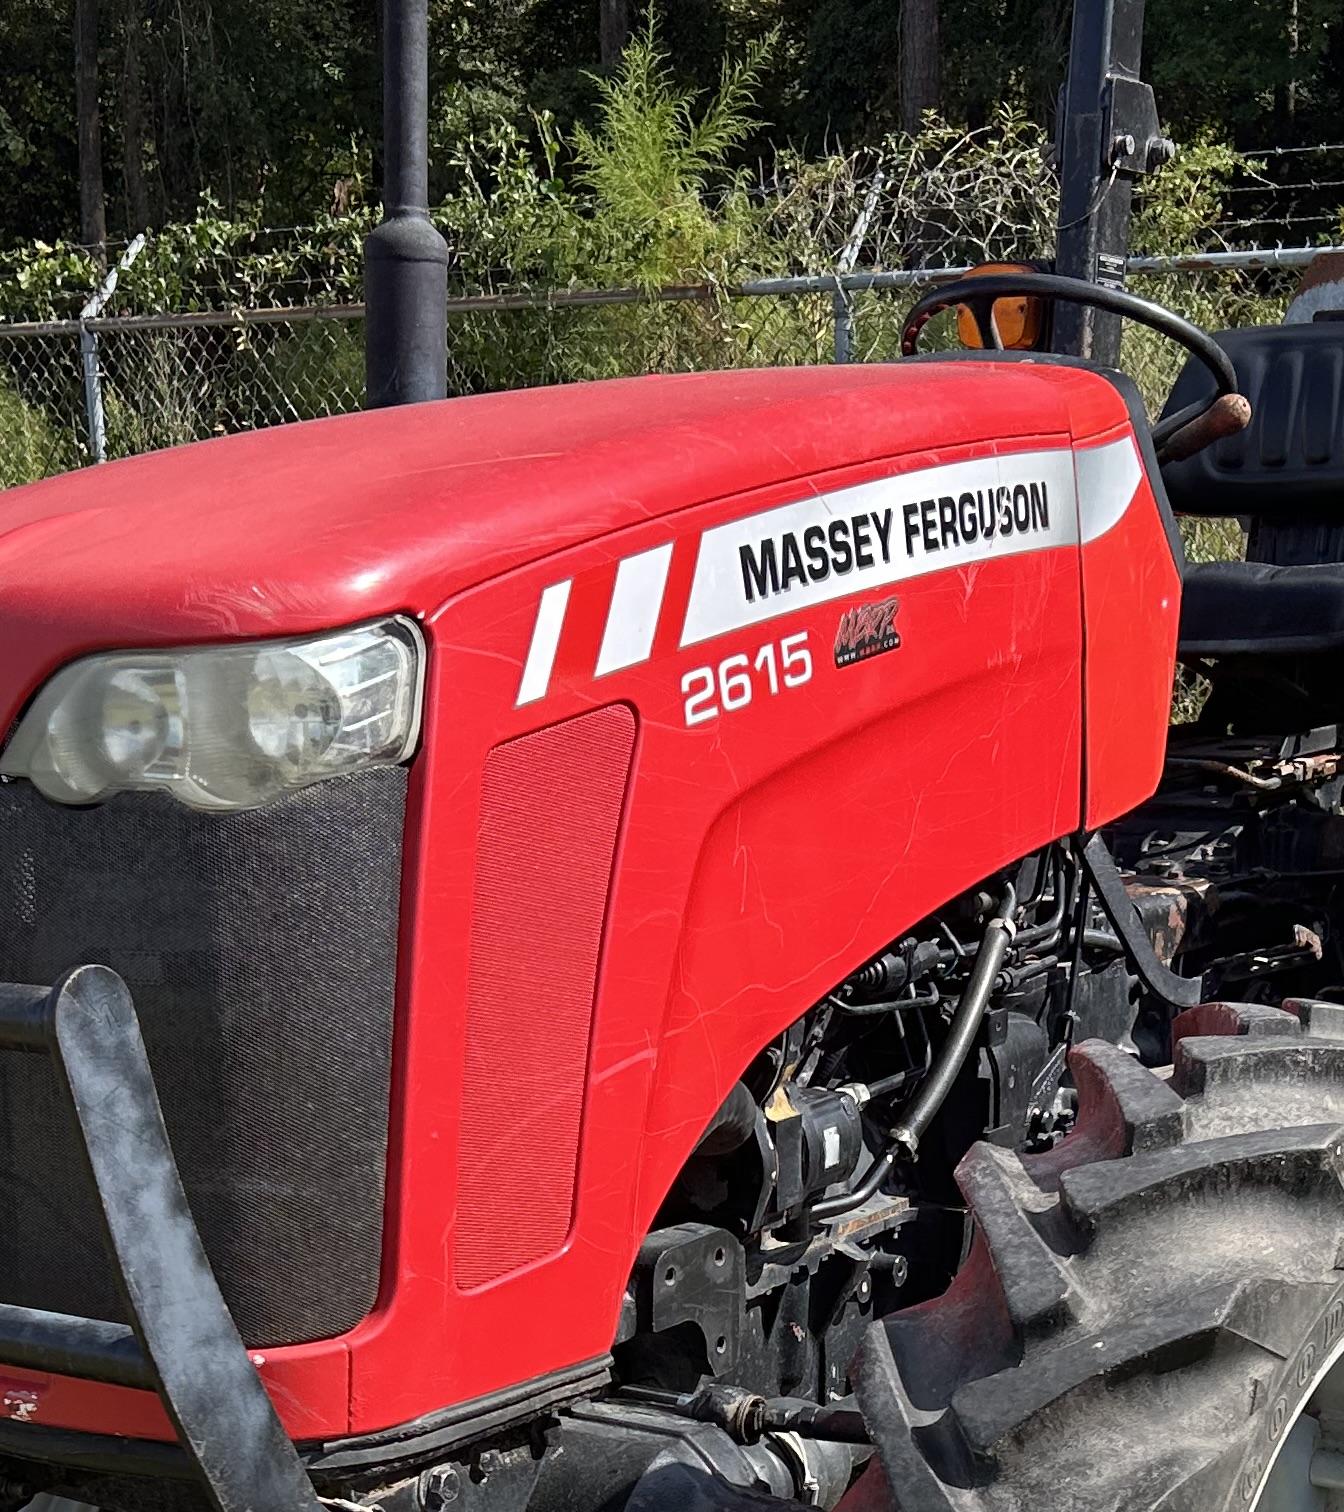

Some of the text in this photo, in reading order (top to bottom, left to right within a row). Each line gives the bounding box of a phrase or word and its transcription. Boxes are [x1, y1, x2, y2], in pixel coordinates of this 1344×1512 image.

[738, 481, 1050, 602] MASSEY FERGUSON
[681, 631, 813, 727] 2615
